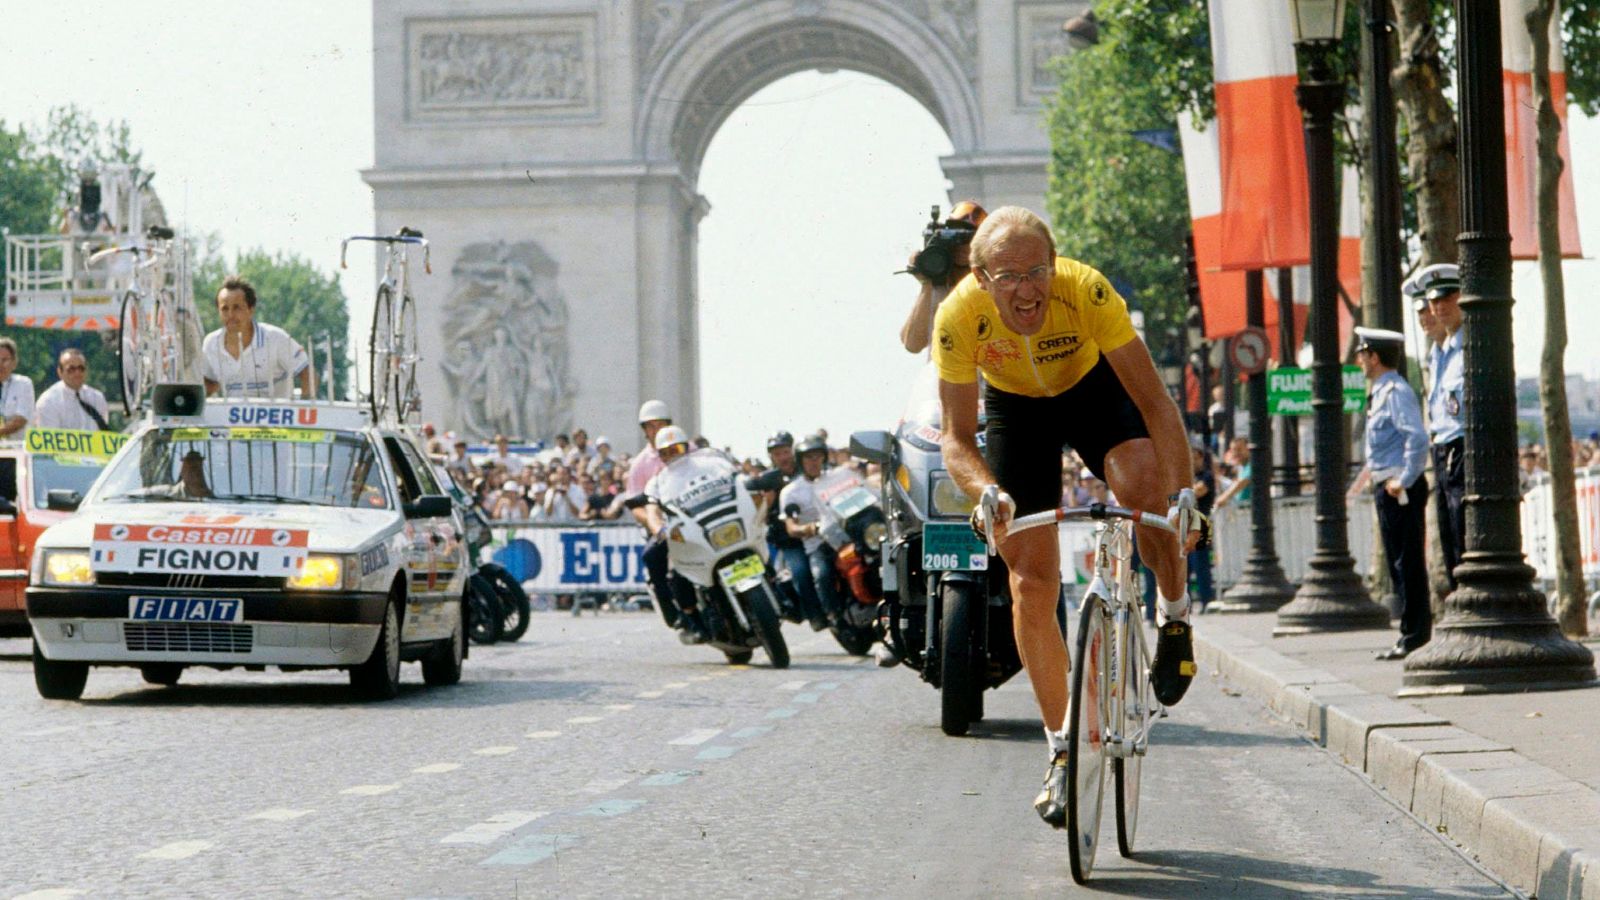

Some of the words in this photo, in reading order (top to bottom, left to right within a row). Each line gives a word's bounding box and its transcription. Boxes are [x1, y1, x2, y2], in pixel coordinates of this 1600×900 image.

[1270, 371, 1366, 393] FUJICME
[228, 406, 294, 425] SUPER
[297, 408, 318, 425] U
[29, 430, 93, 452] CREDIT
[146, 525, 256, 545] Castelli
[137, 547, 259, 571] FIGNON
[924, 553, 959, 569] 2006
[139, 599, 234, 620] FIAT
